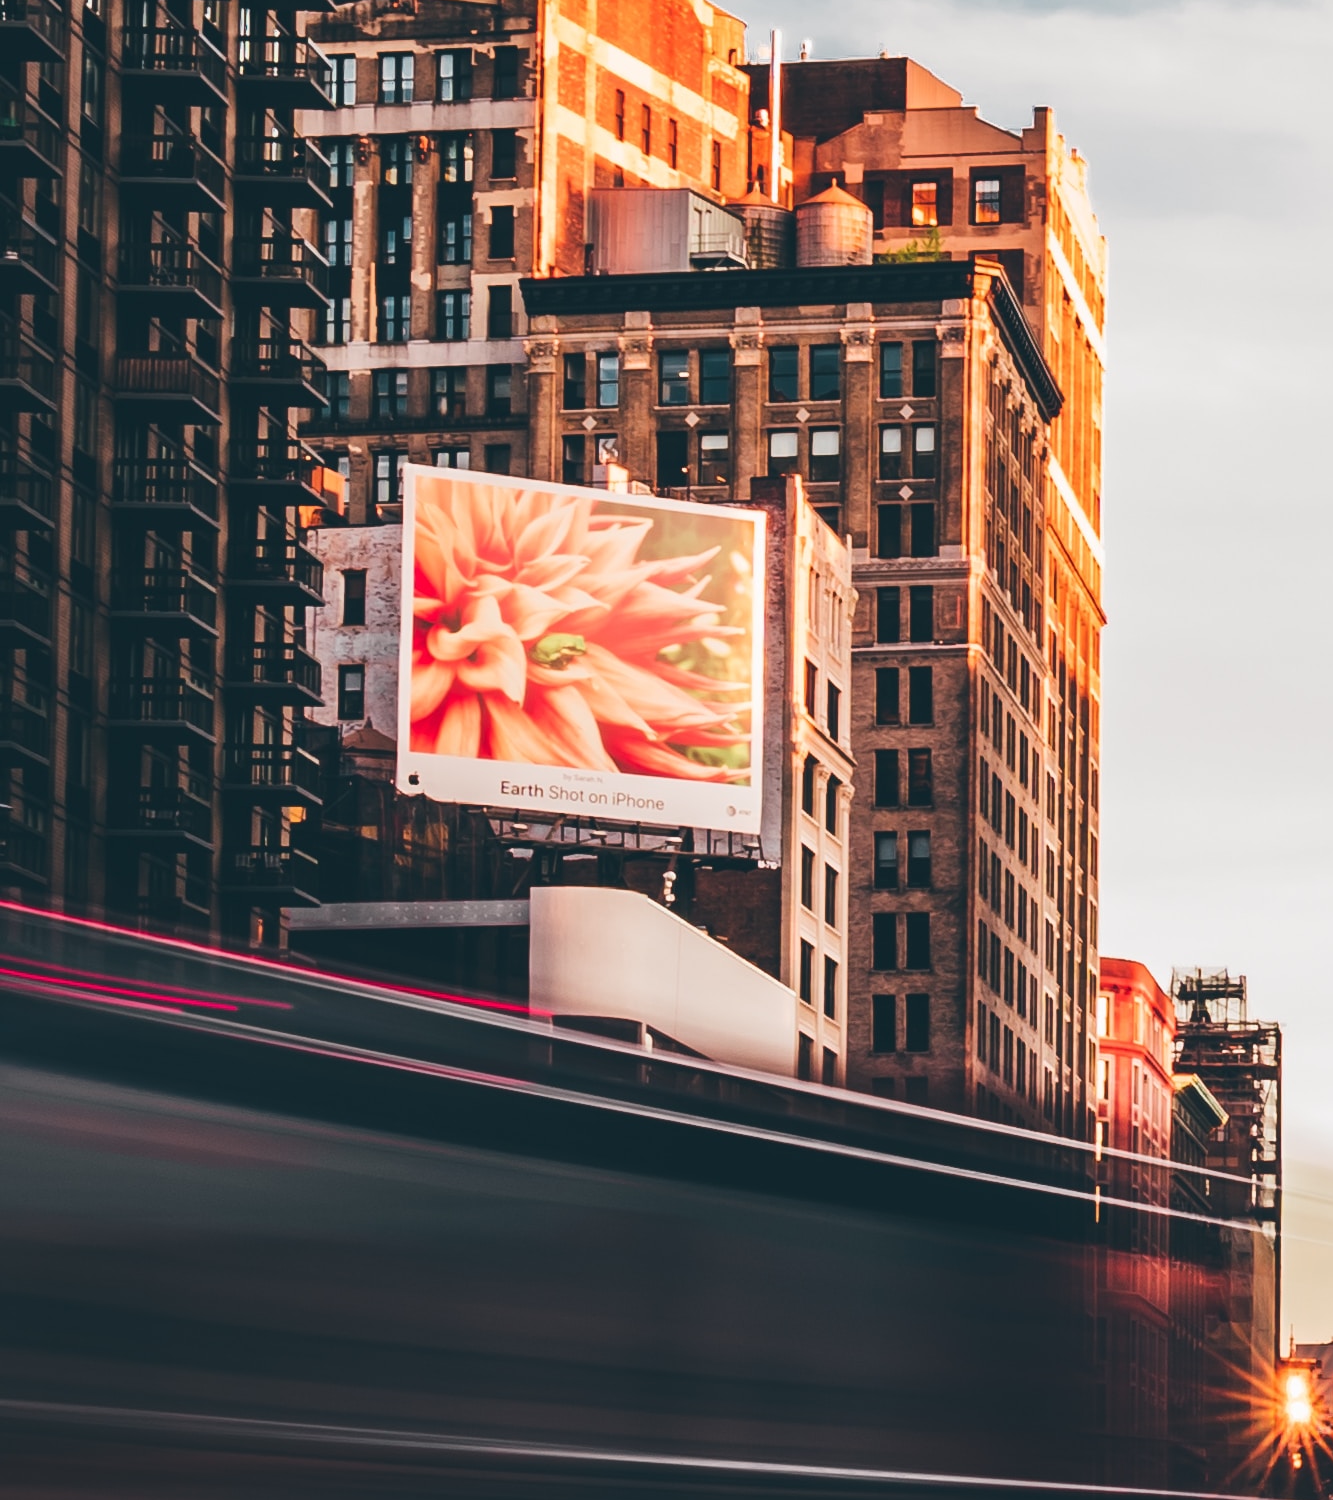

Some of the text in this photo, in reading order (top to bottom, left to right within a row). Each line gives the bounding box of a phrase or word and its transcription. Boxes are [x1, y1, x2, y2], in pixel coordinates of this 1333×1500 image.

[500, 780, 665, 811] Earth Shot on iPhone
